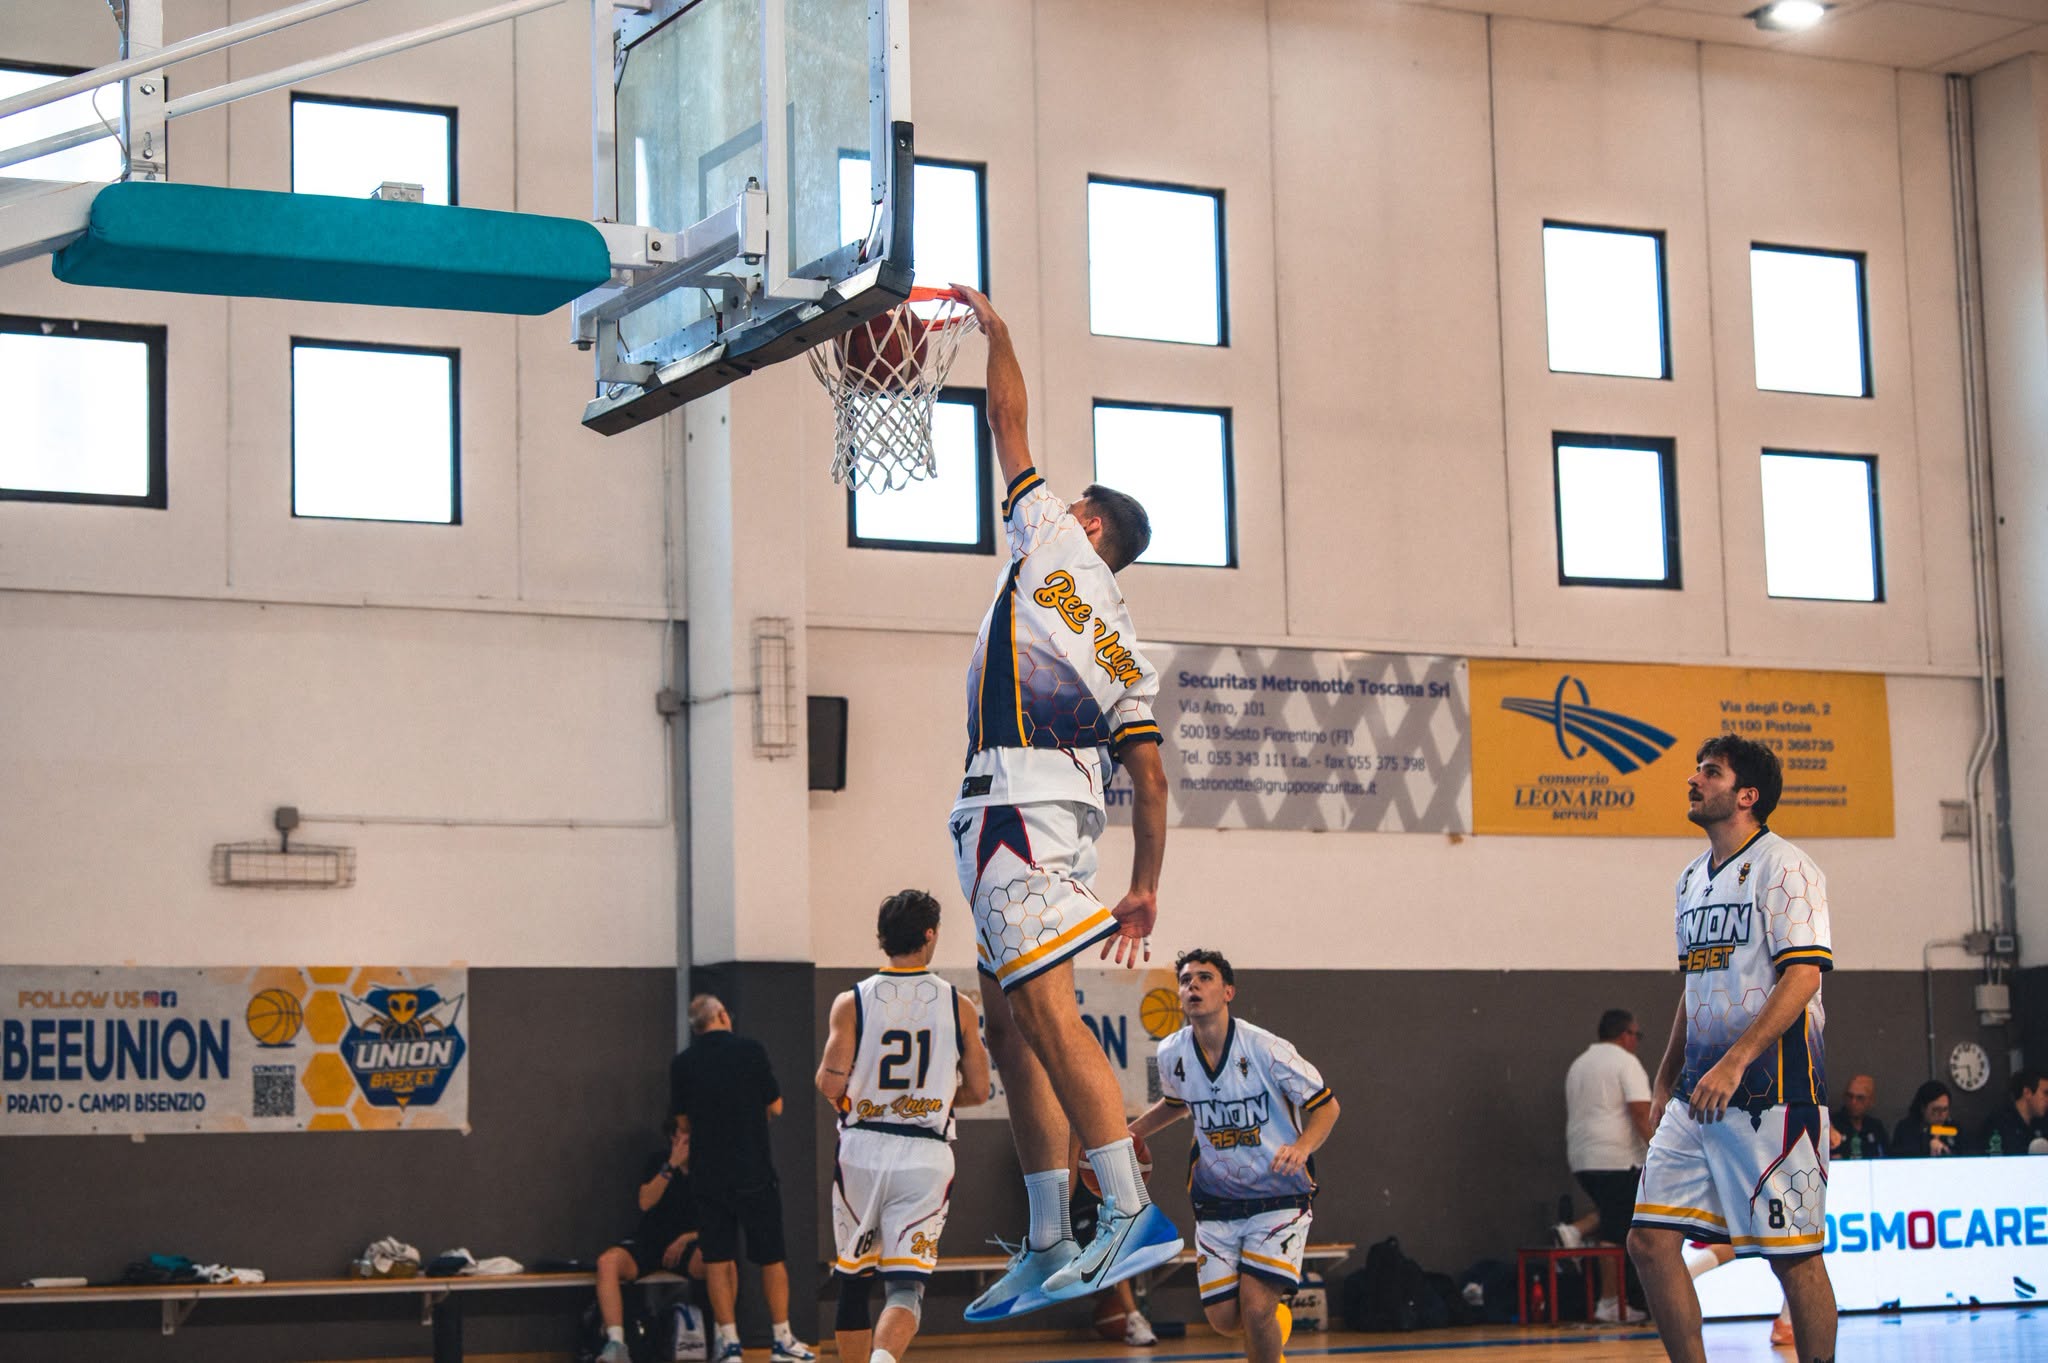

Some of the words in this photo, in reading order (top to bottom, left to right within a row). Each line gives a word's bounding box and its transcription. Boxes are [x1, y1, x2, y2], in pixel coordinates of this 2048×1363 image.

[1033, 569, 1093, 635] Bee
[1178, 671, 1257, 690] Securitas
[1262, 674, 1354, 695] Metronotte
[1358, 678, 1424, 697] Toscana
[1428, 681, 1450, 699] Srl
[1179, 700, 1200, 713] Via
[1243, 702, 1265, 716] 101
[1720, 701, 1741, 713] Via
[1823, 703, 1831, 715] 2
[1180, 725, 1220, 740] 50019
[1224, 727, 1260, 741] Sesto
[1264, 728, 1327, 744] Fiorentino
[1181, 750, 1202, 765] Tel.
[1207, 751, 1232, 766] 055
[1236, 752, 1260, 767] 343
[1325, 754, 1344, 769] fax
[1348, 756, 1371, 770] 055
[1376, 756, 1399, 771] 375
[1403, 757, 1425, 772] 398
[1515, 788, 1635, 808] LEONARDO
[1680, 902, 1753, 946] NION
[18, 991, 109, 1009] FOLLOW
[113, 991, 141, 1008] US
[2, 1018, 230, 1081] BEEUNION
[355, 1039, 453, 1069] UNION
[879, 1029, 931, 1090] 21
[369, 1070, 439, 1089] BASKET
[1174, 1057, 1185, 1082] 4
[7, 1094, 63, 1113] PRATO
[79, 1093, 131, 1112] CAMPI
[135, 1093, 206, 1112] BISENZIO
[890, 1093, 943, 1119] Union
[1768, 1199, 1785, 1229] 8
